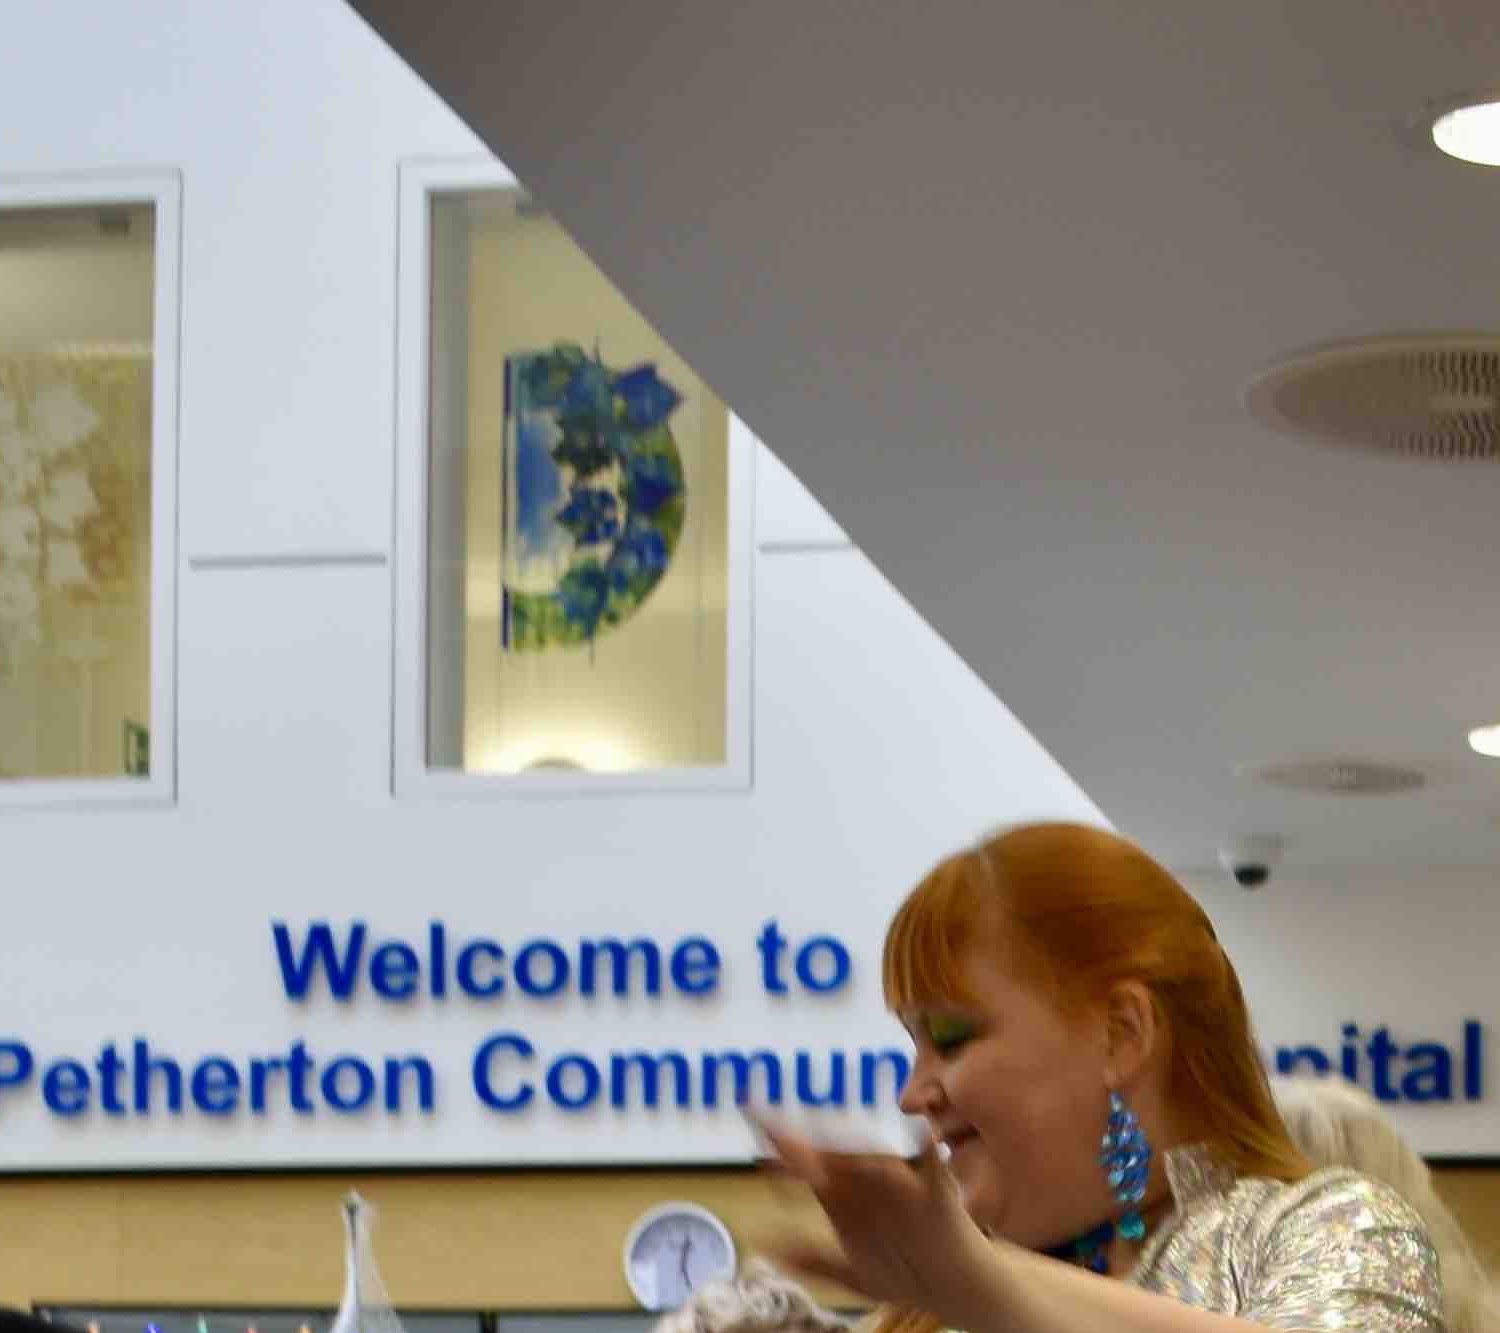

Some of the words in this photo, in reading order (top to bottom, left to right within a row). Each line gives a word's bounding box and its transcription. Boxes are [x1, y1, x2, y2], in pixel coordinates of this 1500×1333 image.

[270, 918, 723, 1001] Welcome
[754, 920, 853, 996] to
[469, 1030, 912, 1113] Commun
